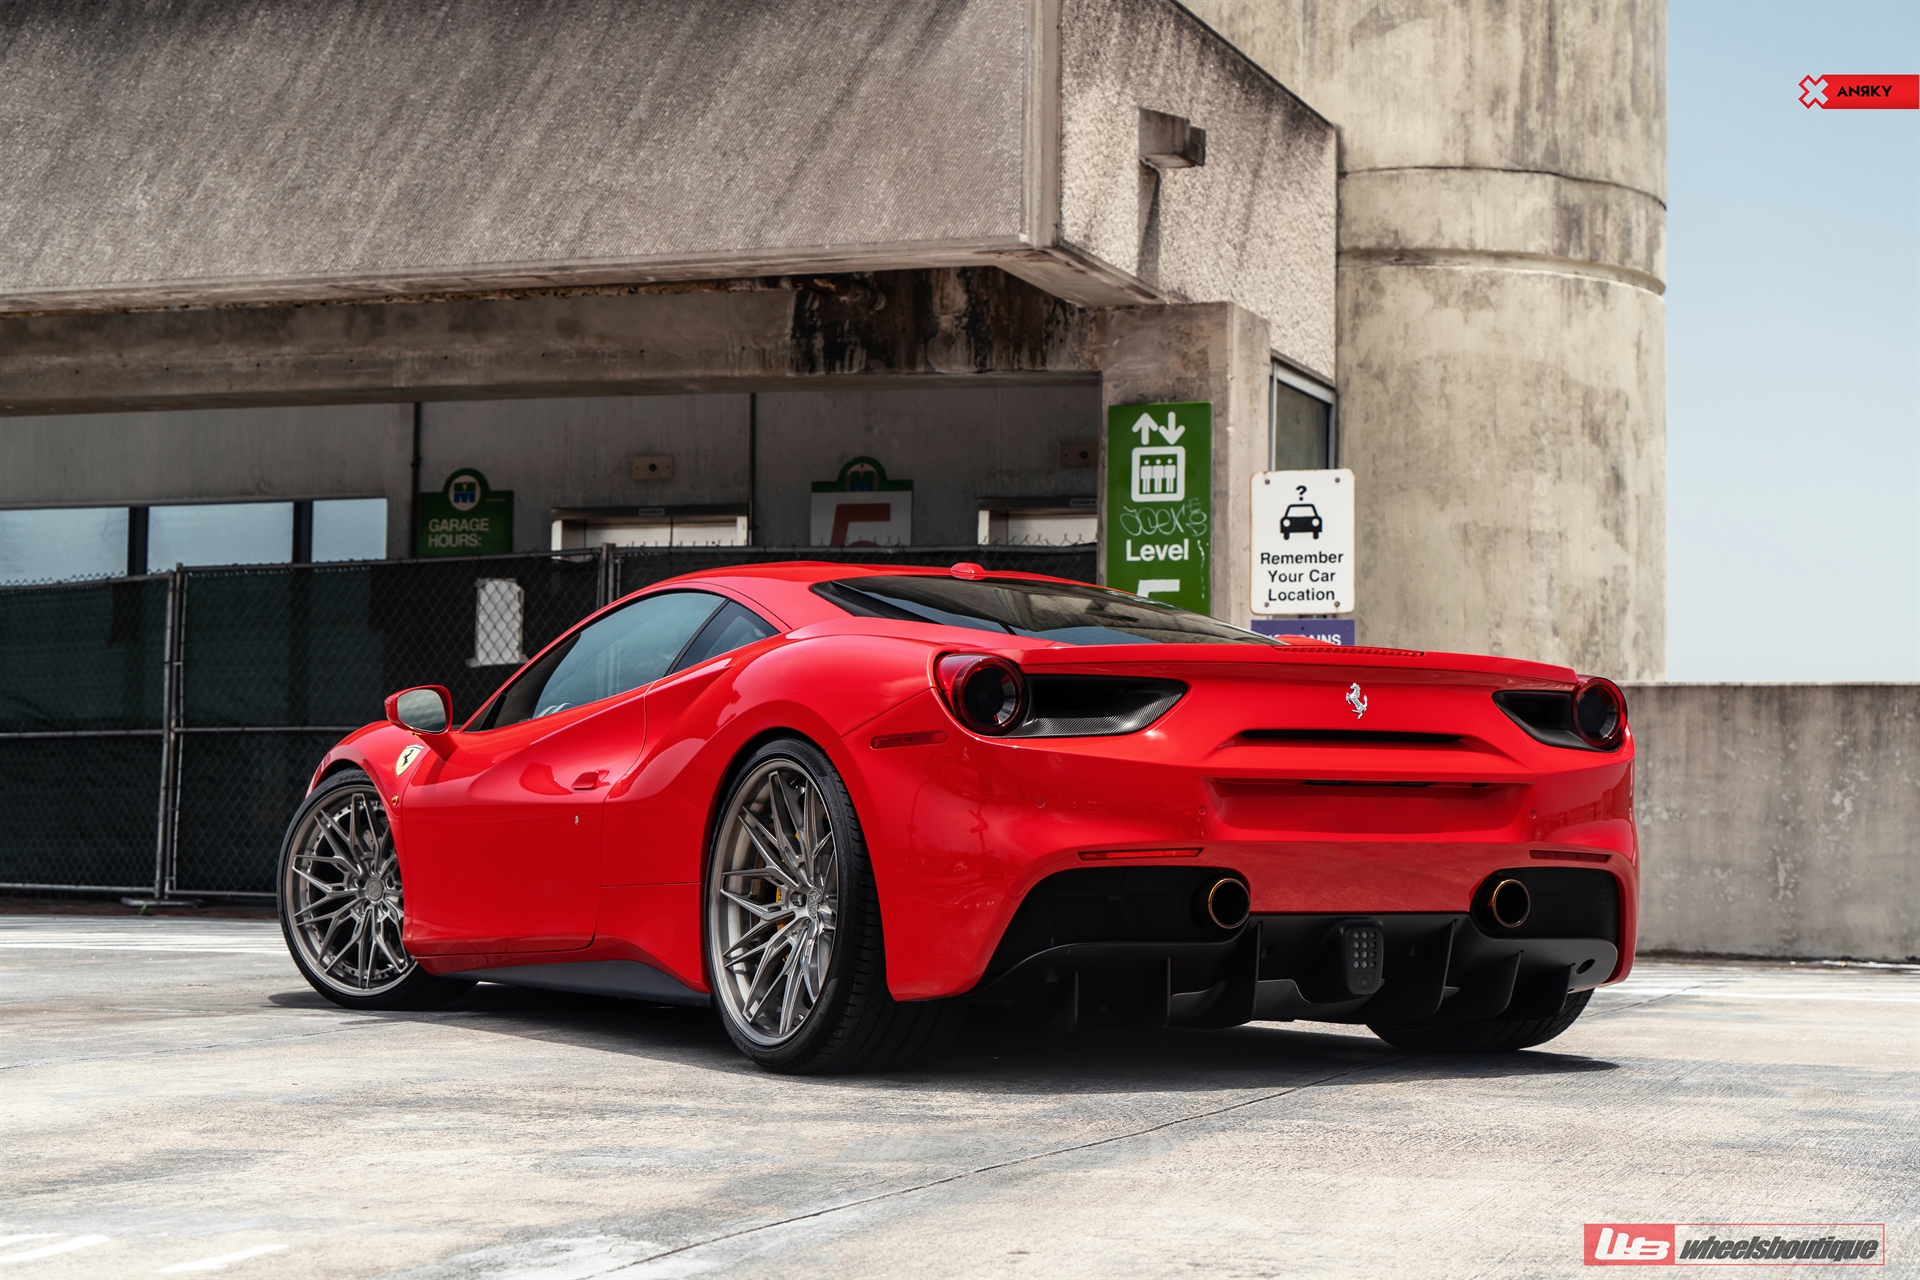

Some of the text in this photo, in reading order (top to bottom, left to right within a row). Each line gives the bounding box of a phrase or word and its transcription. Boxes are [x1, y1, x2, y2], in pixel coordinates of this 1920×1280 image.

[428, 518, 490, 532] GARAGE
[428, 533, 482, 547] HOURS:
[1125, 538, 1190, 562] Level
[1260, 551, 1344, 566] Remember
[1268, 569, 1336, 583] Your Car
[1267, 588, 1336, 602] Location
